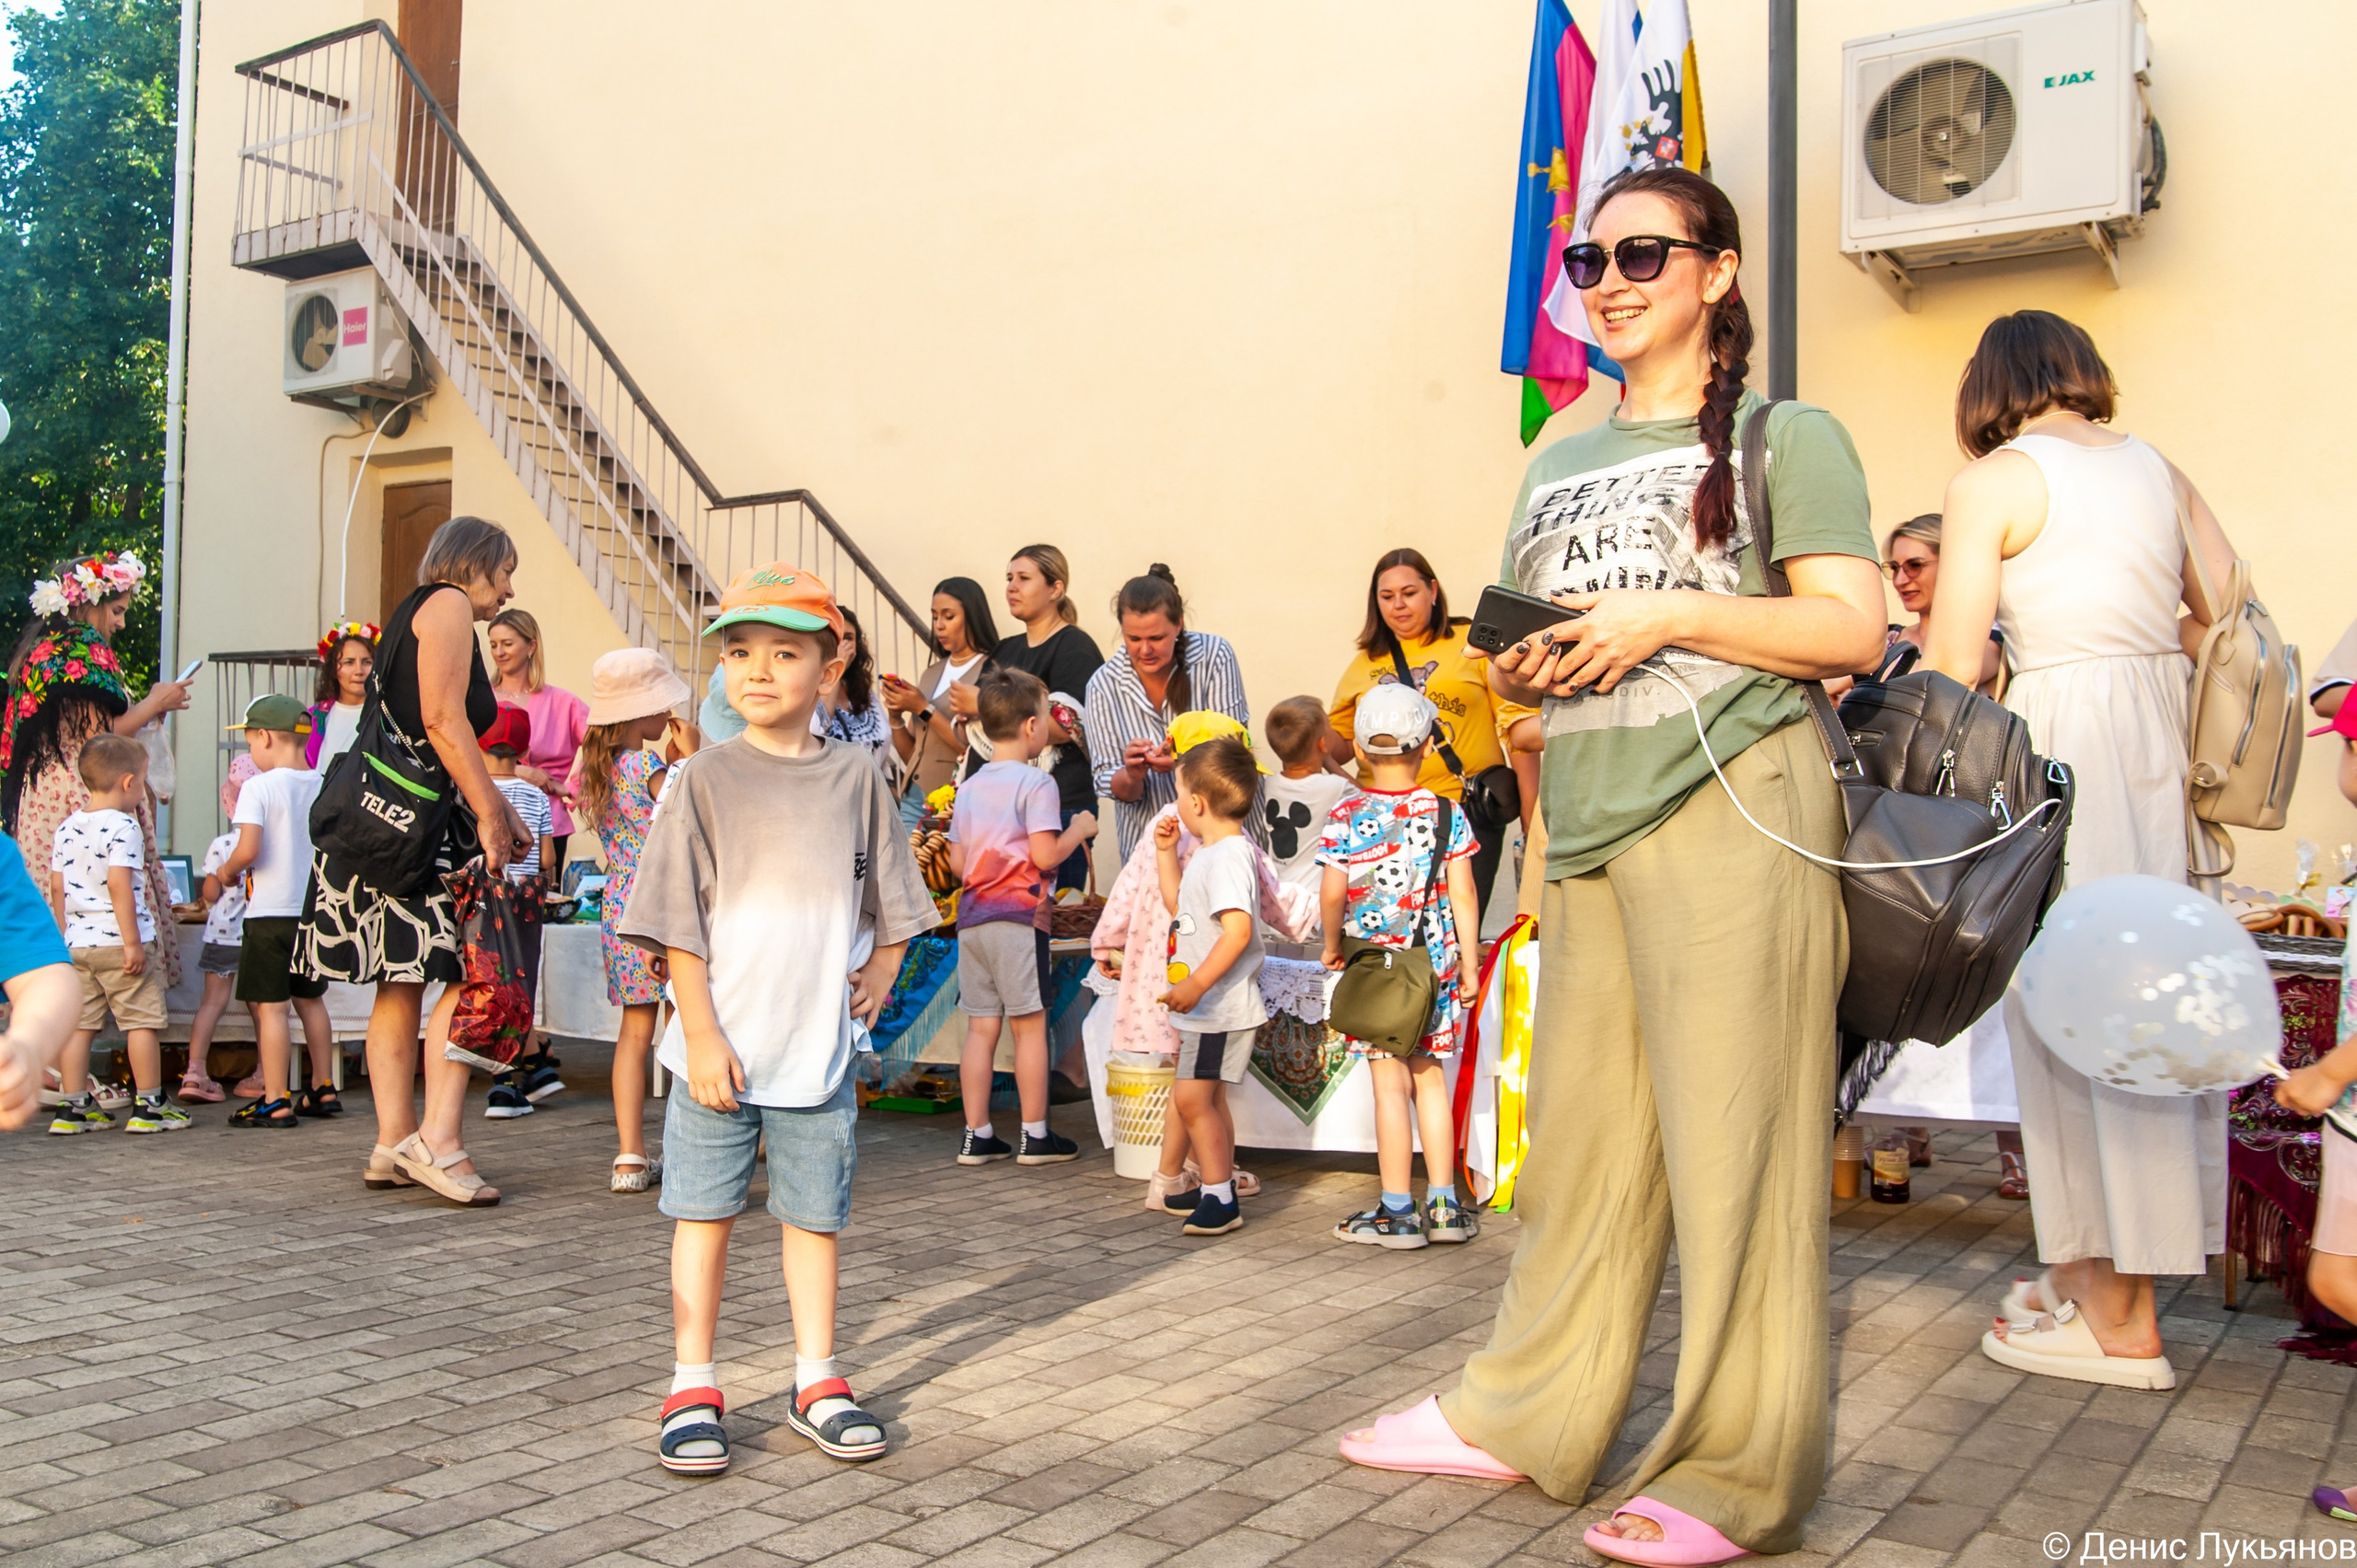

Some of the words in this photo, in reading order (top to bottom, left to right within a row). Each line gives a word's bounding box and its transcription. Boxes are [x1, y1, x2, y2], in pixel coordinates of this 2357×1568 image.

[343, 321, 366, 333] Haier
[1562, 515, 1655, 571] ARE
[1429, 691, 1467, 717] this
[360, 791, 416, 833] TELE2
